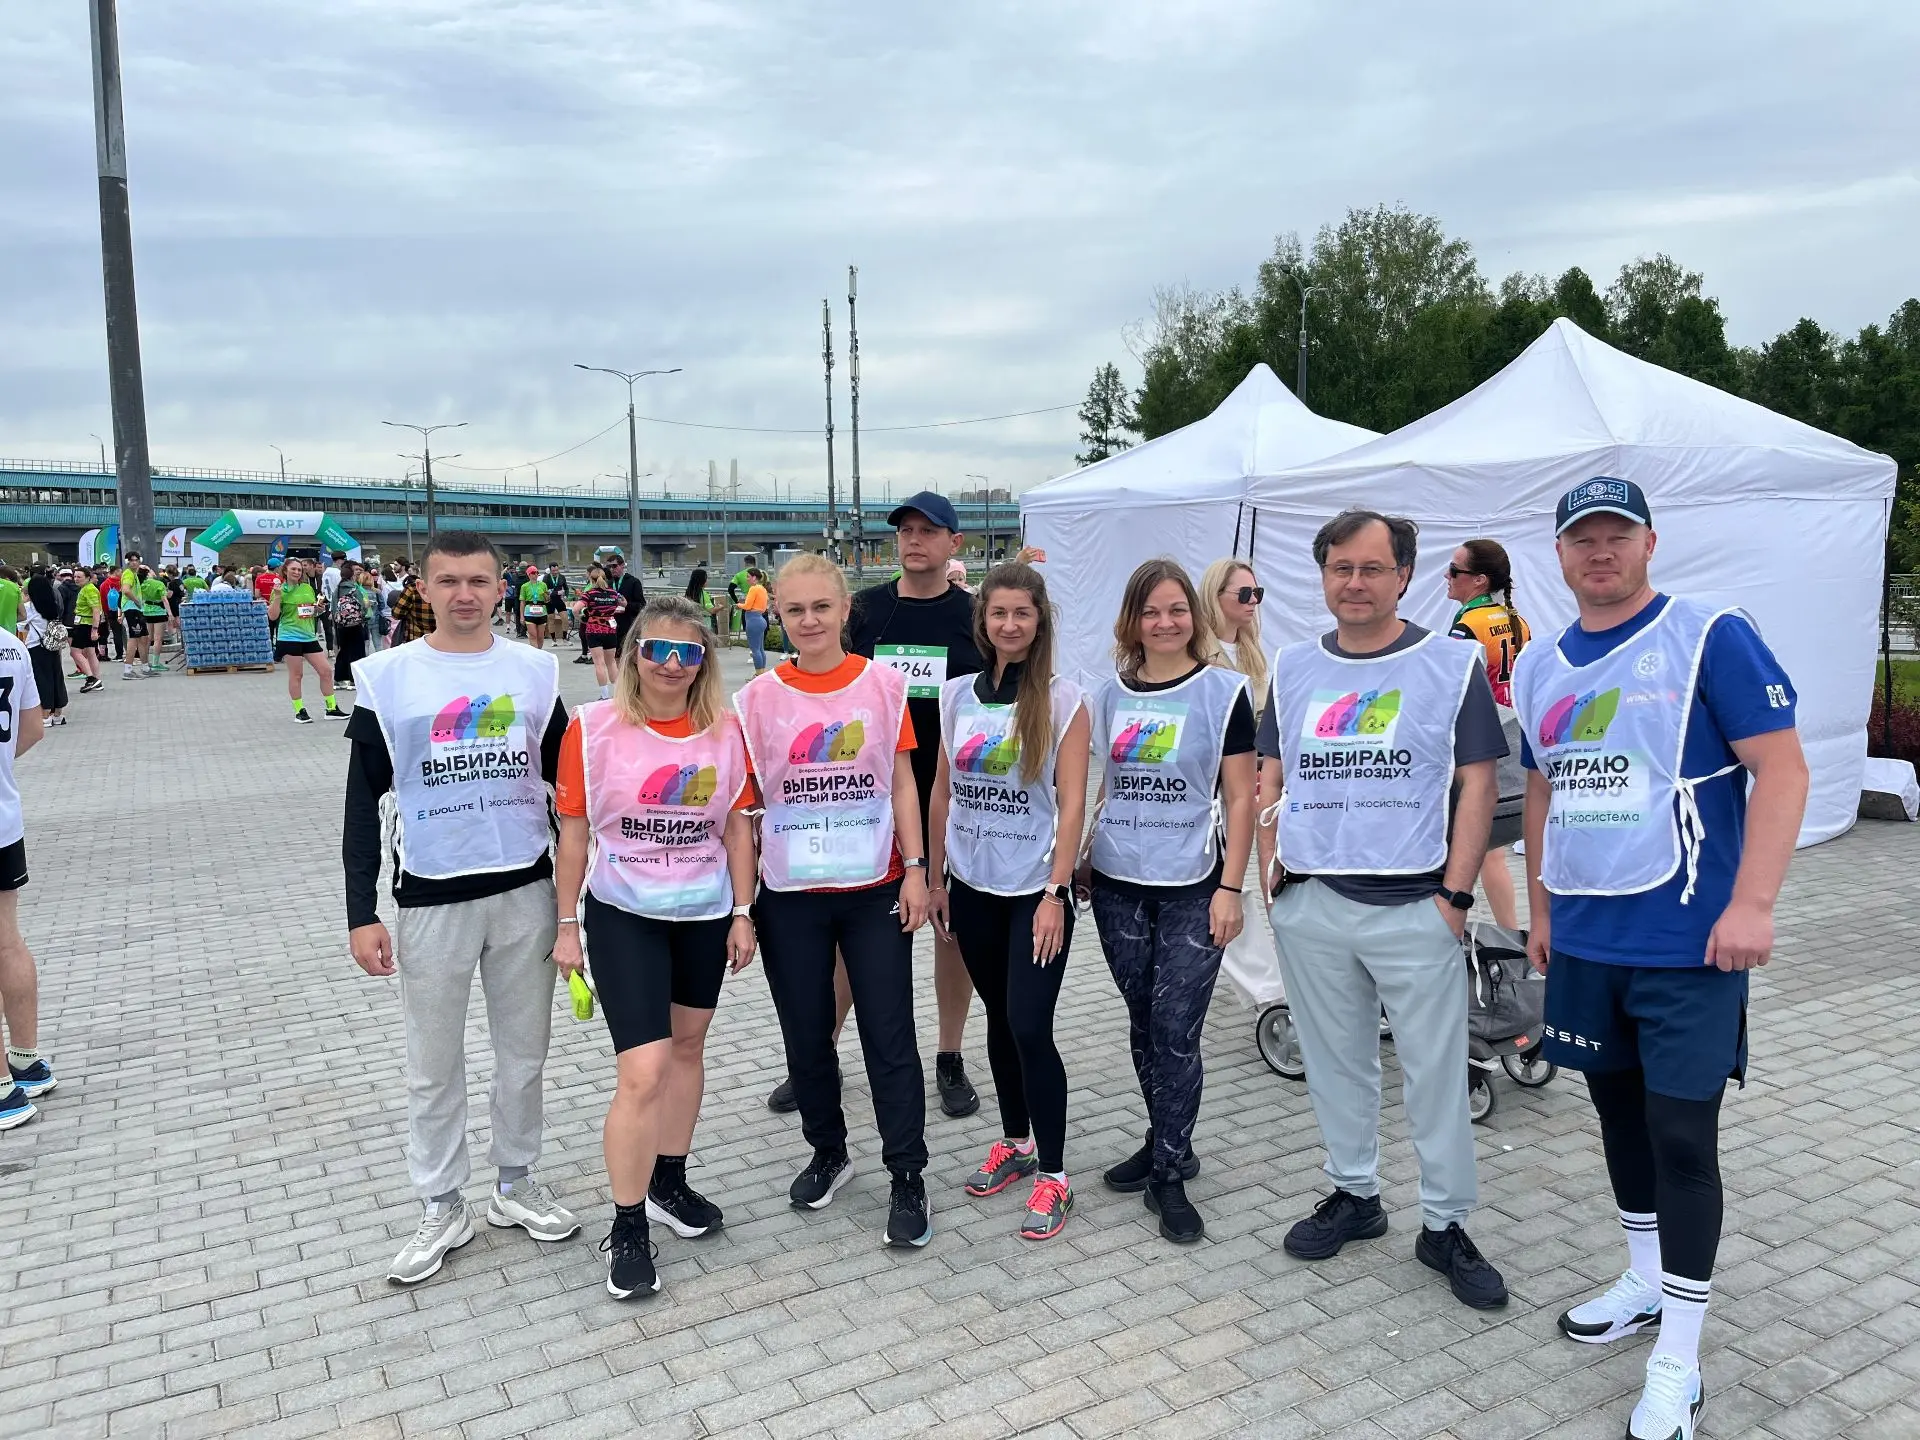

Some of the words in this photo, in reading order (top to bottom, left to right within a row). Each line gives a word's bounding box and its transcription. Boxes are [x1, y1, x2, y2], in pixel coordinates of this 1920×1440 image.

[1572, 487, 1587, 502] 19
[1607, 483, 1624, 496] 62
[257, 518, 304, 529] СТАРТ
[421, 751, 529, 777] ВЫБИРАЮ
[1300, 749, 1411, 769] ВЫБИРАЮ
[424, 770, 480, 788] ЧИСТЫЙ
[483, 768, 529, 779] ВОЗДУХ
[1299, 769, 1352, 781] ЧИСТЫЙ
[1354, 768, 1411, 780] ВОЗДУХ
[783, 773, 875, 794] ВЫБИРАЮ
[1569, 776, 1629, 790] ВОЗДУХ
[784, 792, 829, 805] ЧИСТЫЙ
[832, 790, 876, 802] ВОЗДУХ
[953, 781, 1029, 804] ВЫБИРАЮ
[428, 802, 474, 816] EVOLUTE
[488, 797, 535, 807] экосистема
[984, 802, 1030, 816] ВОЗДУХ
[1303, 801, 1344, 810] EVOLUTE
[1354, 799, 1420, 809] экосистема
[1139, 820, 1195, 828] экосистема
[1568, 812, 1640, 823] экосистема
[621, 830, 675, 846] ЧИСТЫЙ
[982, 829, 1037, 841] экосистема
[619, 855, 660, 864] EVOLUTE
[1543, 1023, 1602, 1051] ESET
